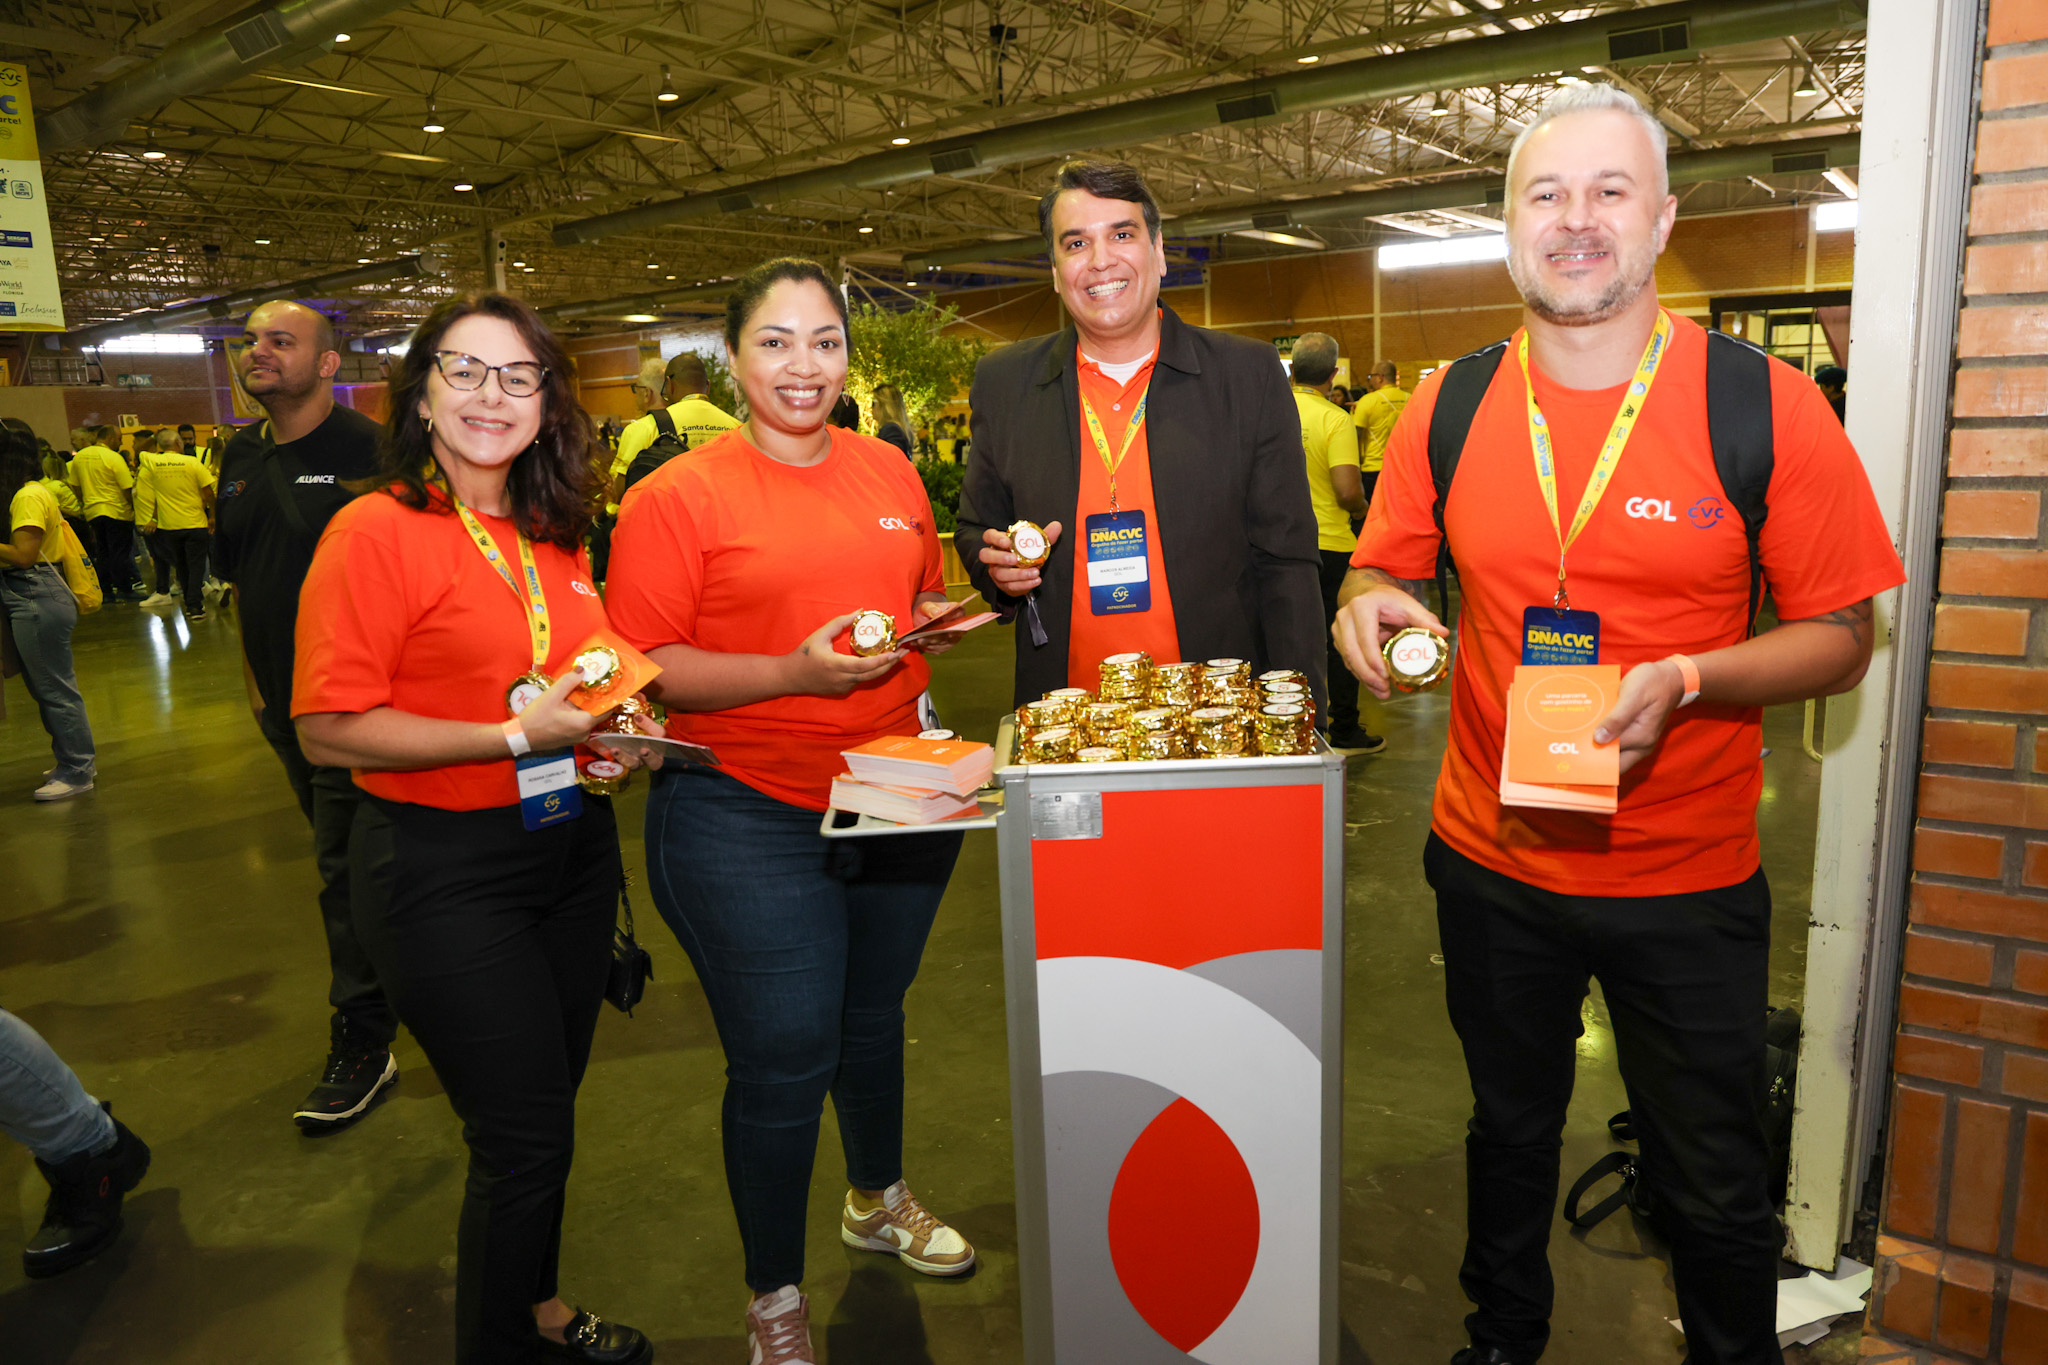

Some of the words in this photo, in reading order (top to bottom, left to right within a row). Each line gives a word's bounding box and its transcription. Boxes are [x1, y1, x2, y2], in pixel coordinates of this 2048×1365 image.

[119, 374, 152, 386] SAÍDA
[295, 475, 335, 484] ALLIANCE
[1625, 496, 1677, 522] GOL
[879, 517, 910, 530] GOL
[1018, 538, 1041, 549] GOL
[858, 625, 880, 637] GOL
[1527, 643, 1551, 651] Orgulho
[1397, 647, 1432, 662] GOL
[1549, 742, 1579, 754] GOL
[592, 763, 617, 774] GOL
